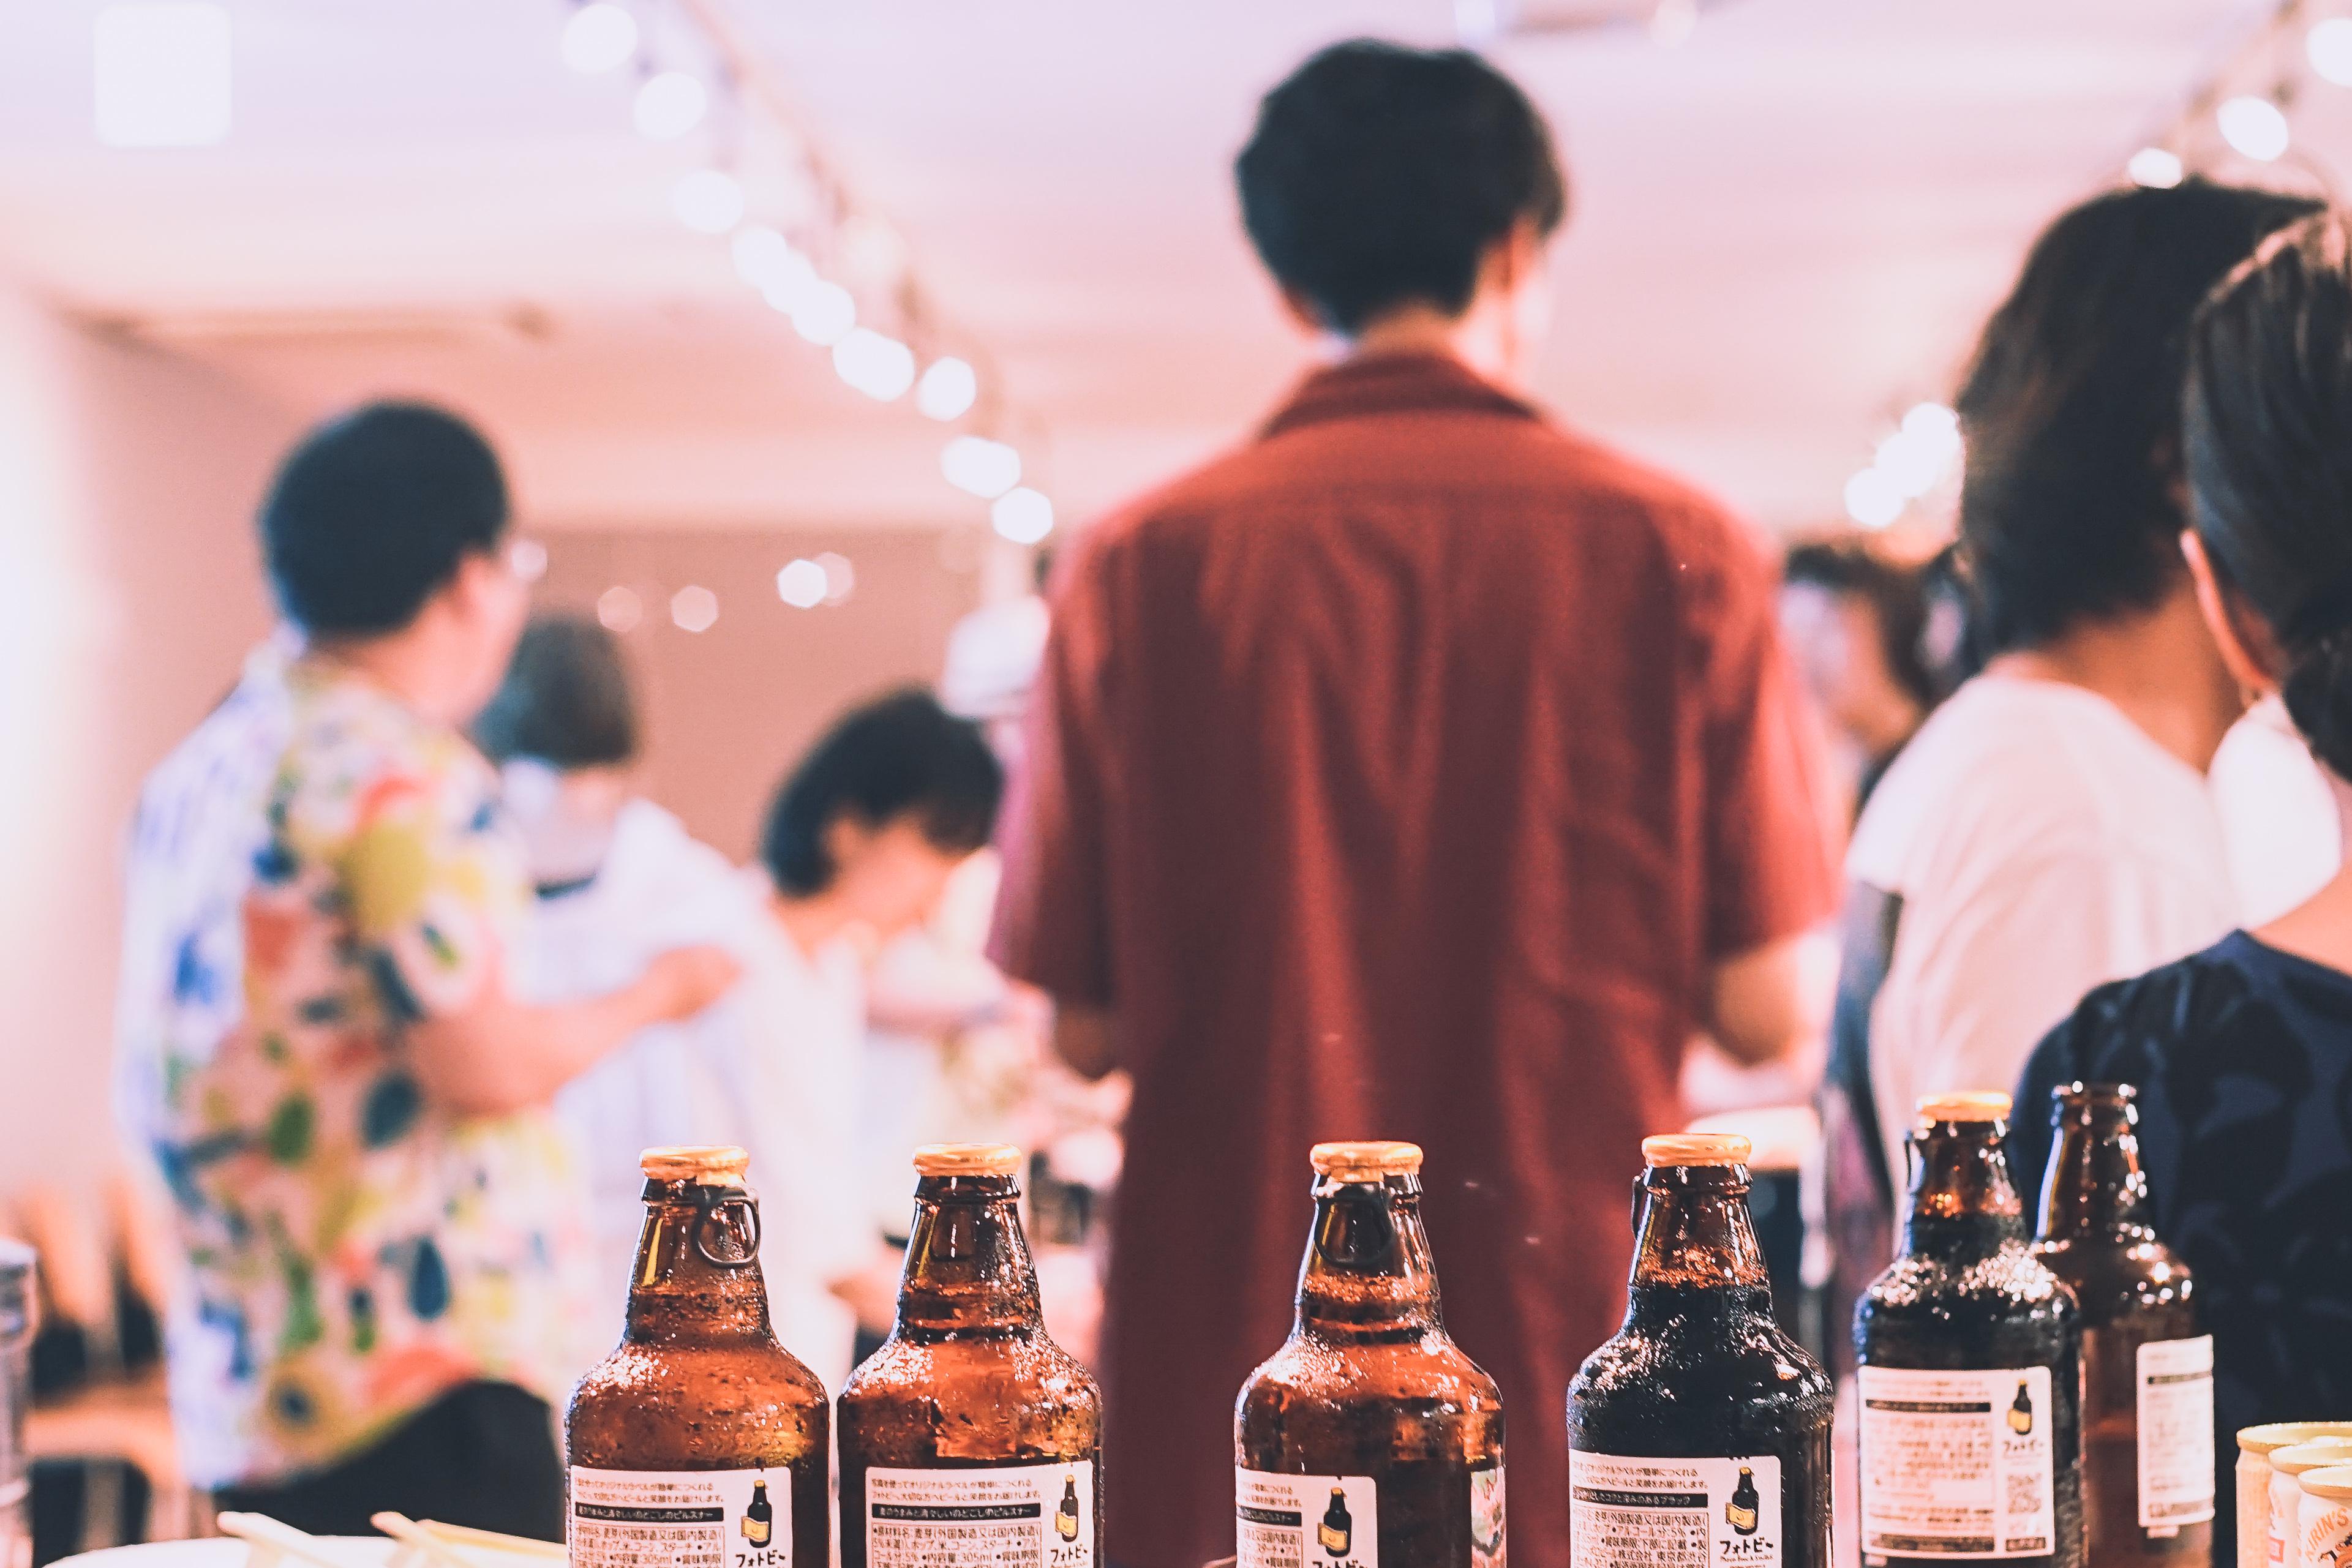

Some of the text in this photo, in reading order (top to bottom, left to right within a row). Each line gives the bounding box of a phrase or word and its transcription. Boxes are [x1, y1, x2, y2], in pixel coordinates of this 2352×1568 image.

[2304, 1508, 2350, 1562] KIRIN'S
[1050, 1544, 1088, 1562] フォトビー
[1719, 1536, 1774, 1555] フォトビー
[735, 1550, 786, 1567] フォトビー
